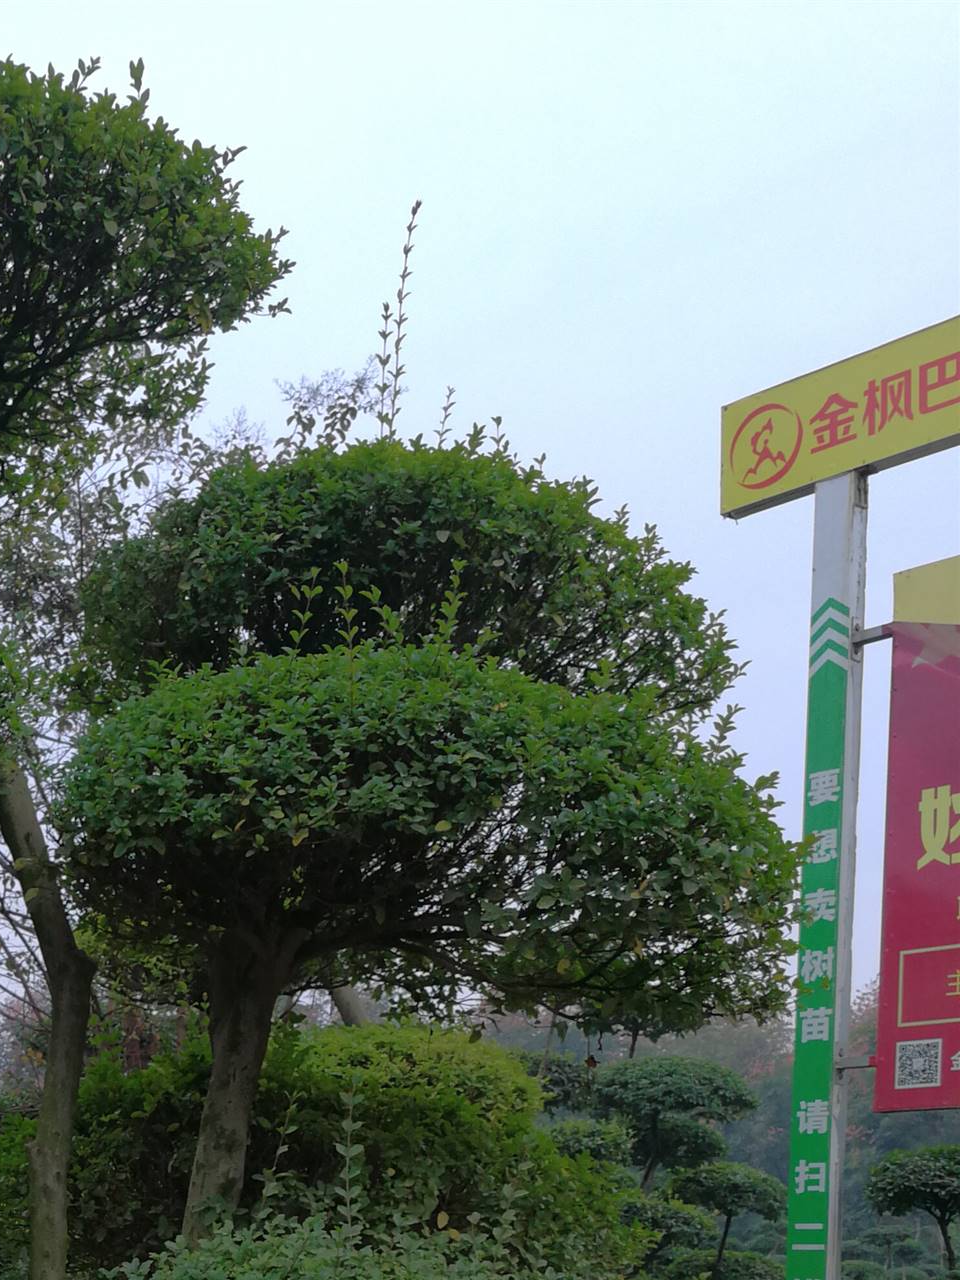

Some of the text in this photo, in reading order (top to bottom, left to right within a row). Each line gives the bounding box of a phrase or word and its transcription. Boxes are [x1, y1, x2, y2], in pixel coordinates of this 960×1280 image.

[799, 768, 841, 1043] 要想卖树苗
